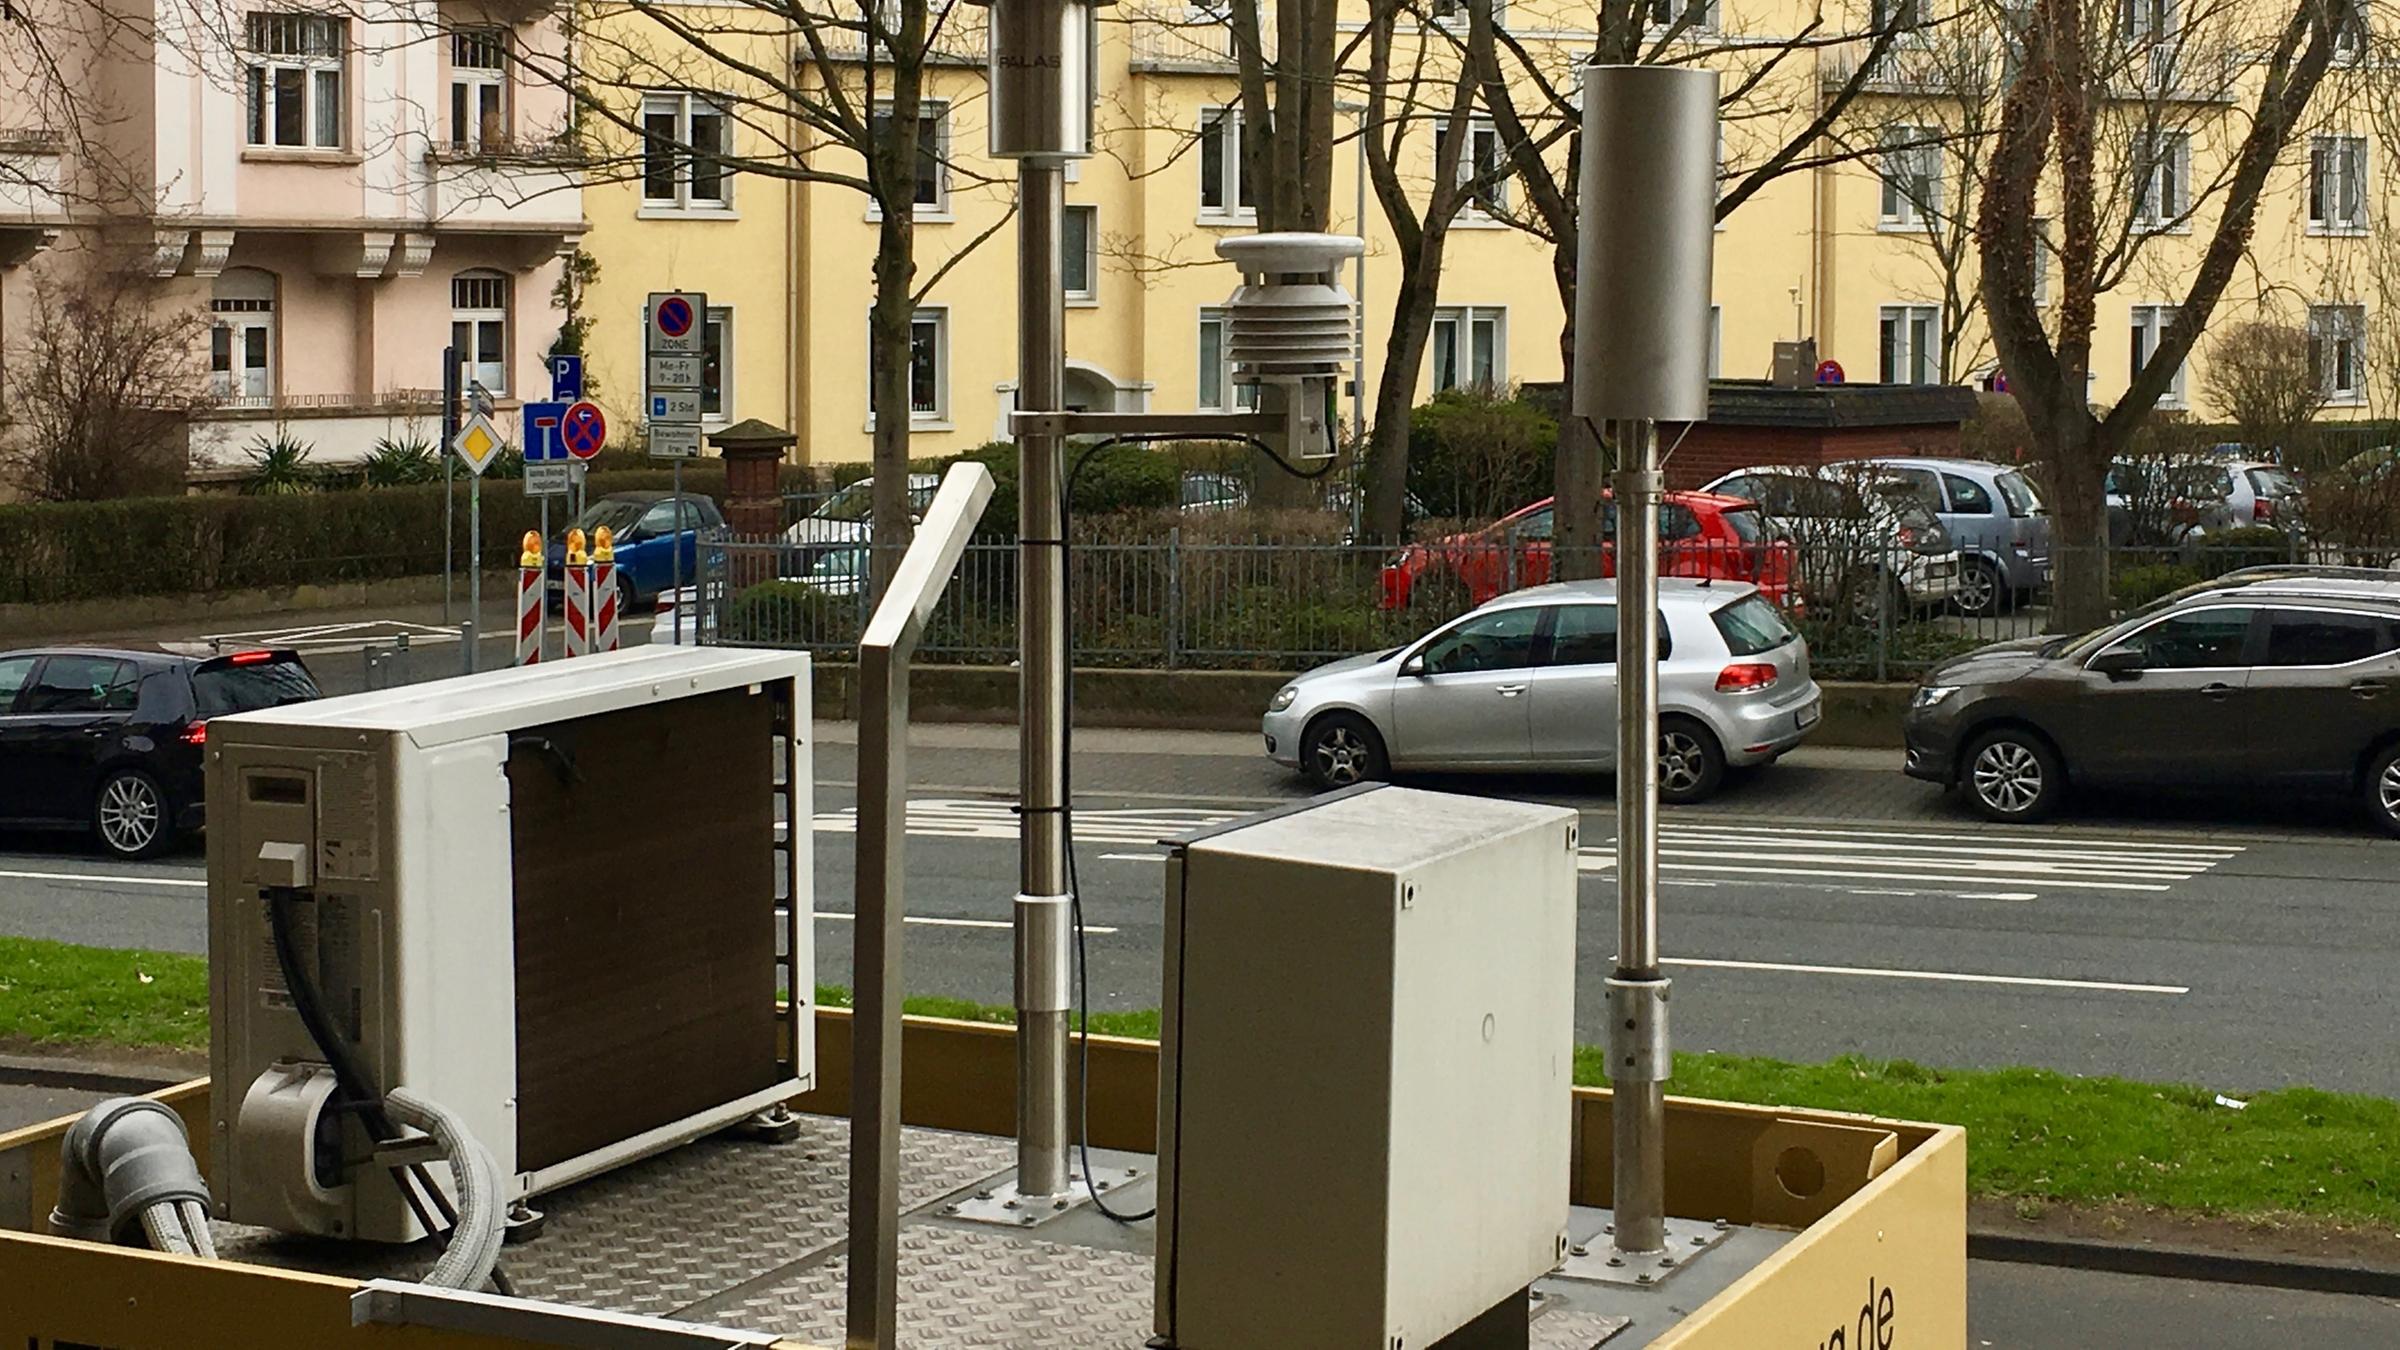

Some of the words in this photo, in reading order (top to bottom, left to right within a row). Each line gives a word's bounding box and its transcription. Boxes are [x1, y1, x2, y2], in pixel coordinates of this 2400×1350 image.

[999, 55, 1062, 69] PALAS
[661, 338, 689, 350] ZONE
[557, 359, 570, 383] P
[670, 401, 677, 412] 2
